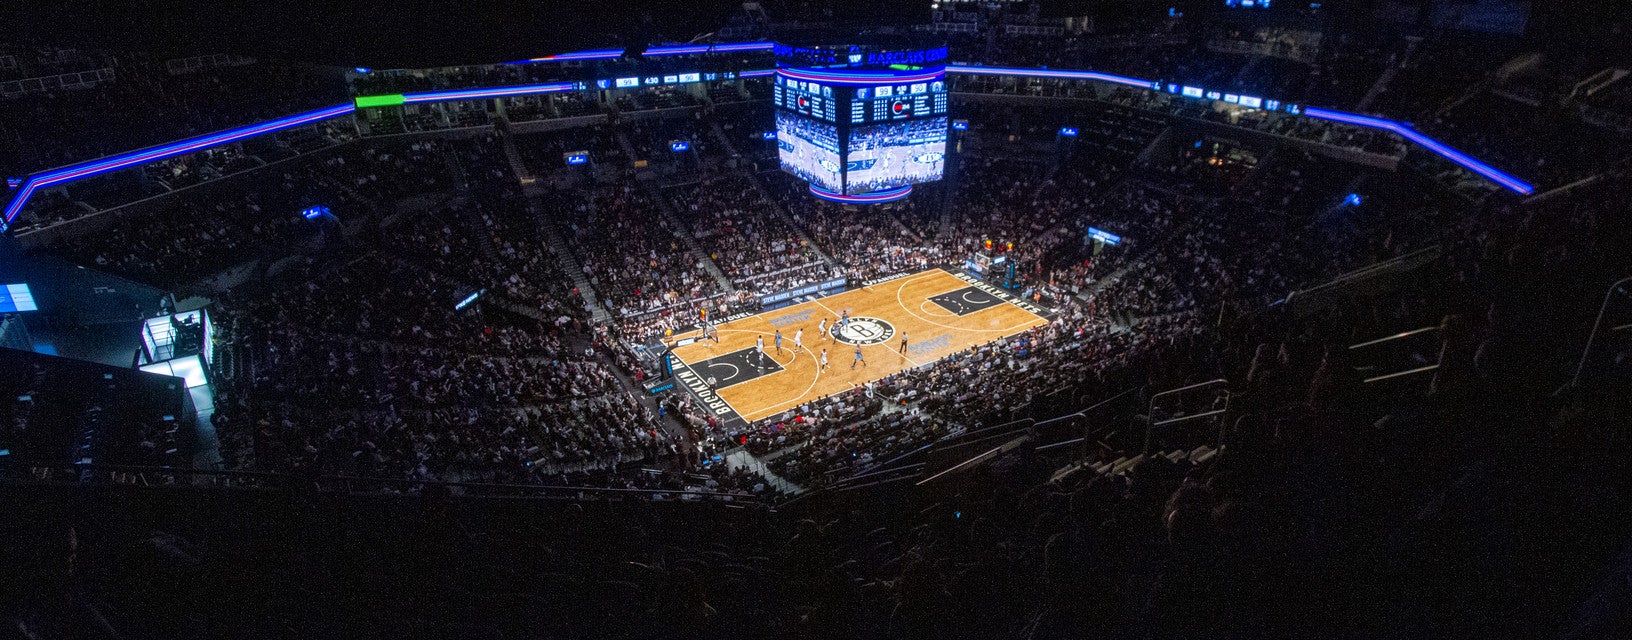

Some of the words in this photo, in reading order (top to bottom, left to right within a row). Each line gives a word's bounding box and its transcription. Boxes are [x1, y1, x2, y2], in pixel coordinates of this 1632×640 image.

[868, 50, 925, 65] BARCLAYS
[644, 76, 659, 85] 4:30
[793, 289, 803, 297] STEVE
[803, 285, 818, 294] MADDEN
[821, 281, 831, 290] STEVE
[831, 278, 845, 287] MADDEN
[954, 272, 1010, 299] BROOKLYN
[1009, 298, 1042, 314] NETS
[876, 329, 893, 343] YORK
[677, 370, 732, 415] BROOKLYN
